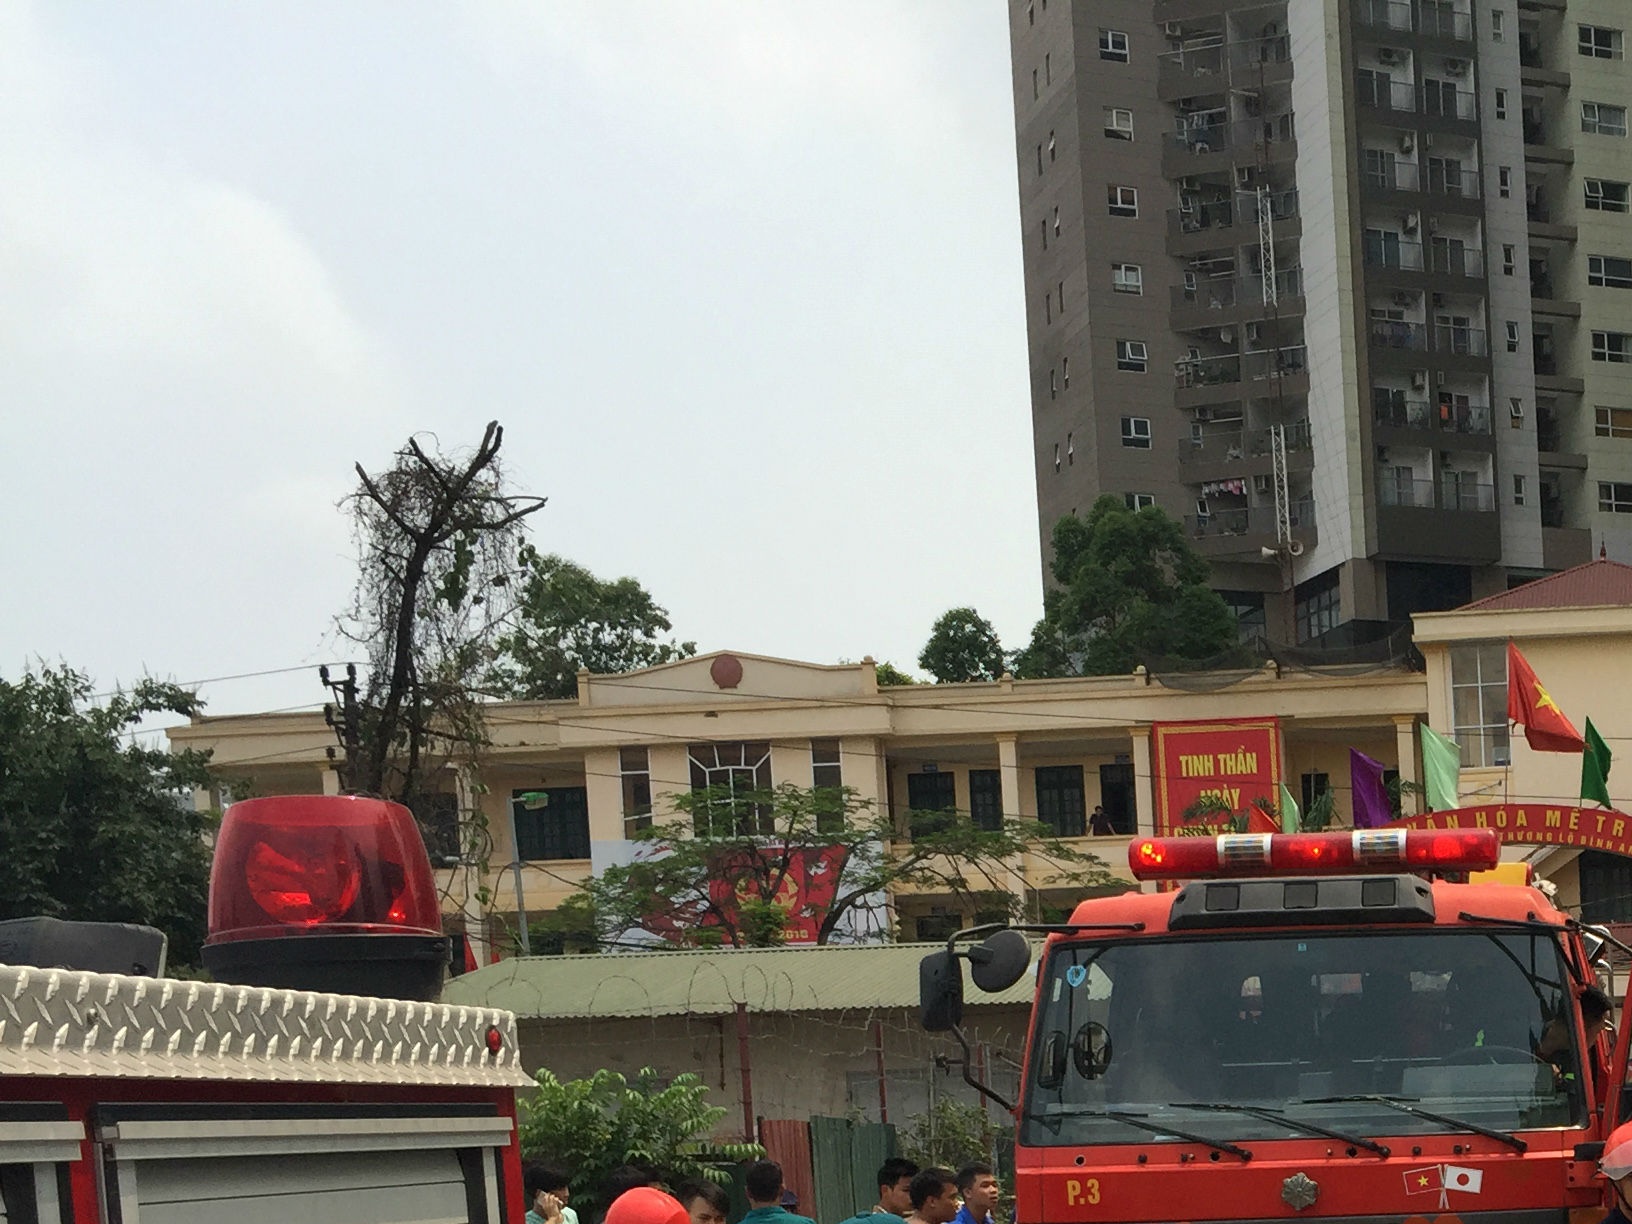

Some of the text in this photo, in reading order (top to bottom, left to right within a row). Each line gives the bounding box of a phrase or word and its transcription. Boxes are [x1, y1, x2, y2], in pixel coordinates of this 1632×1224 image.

[1179, 745, 1258, 777] TINH THẦN
[1475, 806, 1528, 829] HÓA
[1066, 1178, 1101, 1206] P.3
